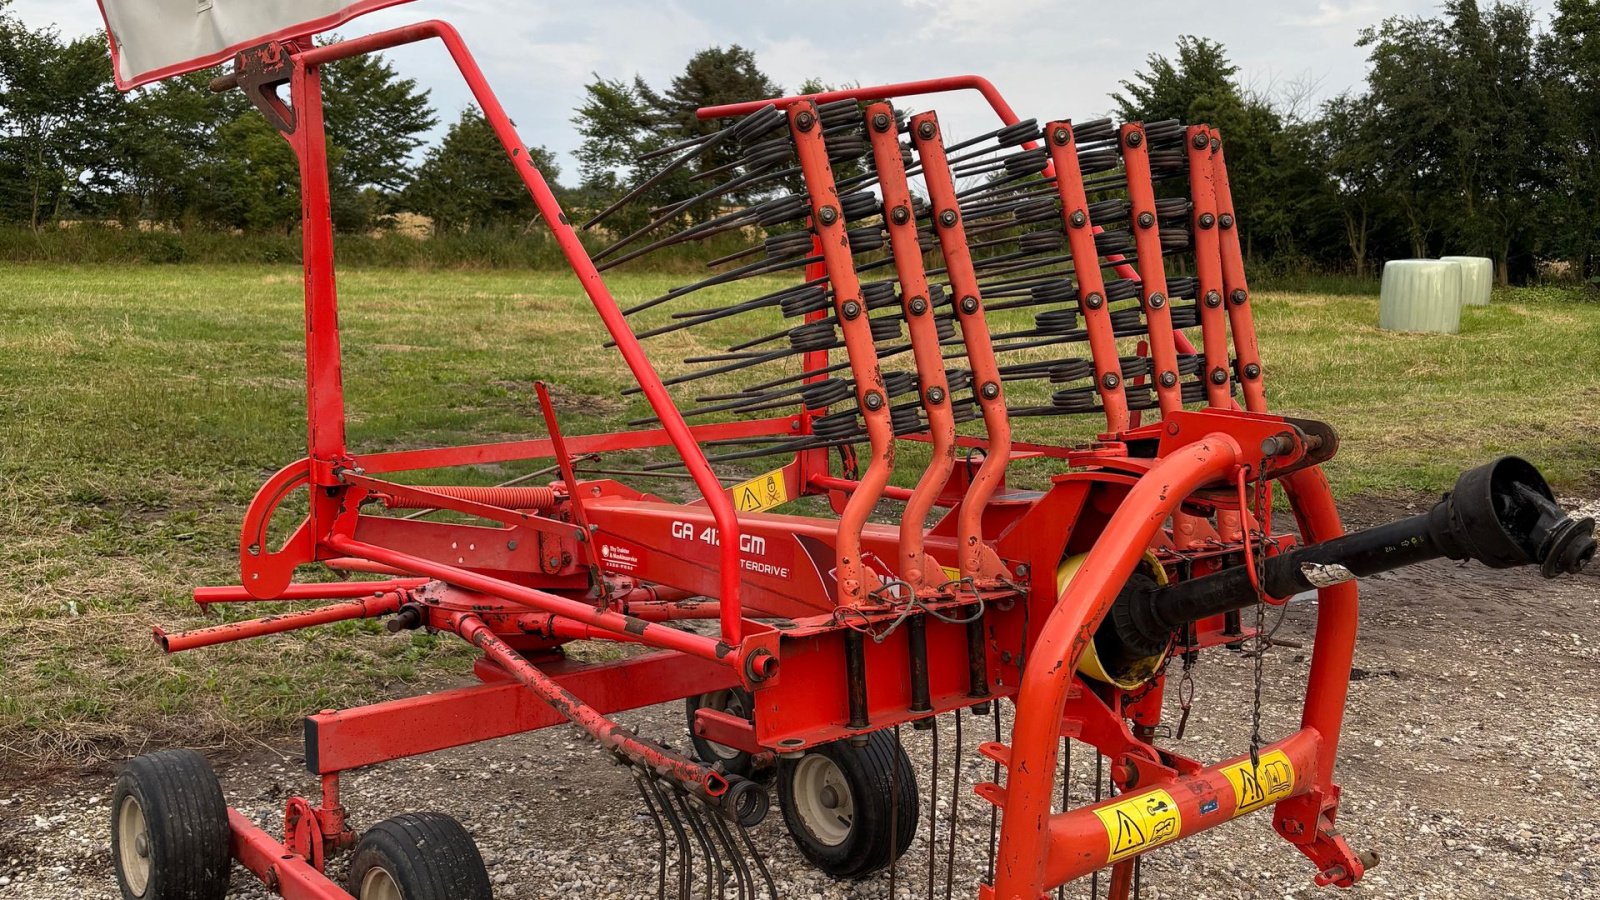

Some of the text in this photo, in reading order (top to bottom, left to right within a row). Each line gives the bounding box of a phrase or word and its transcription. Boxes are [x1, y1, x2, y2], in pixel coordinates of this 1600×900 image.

[672, 520, 694, 541] GA
[739, 533, 766, 556] GM
[740, 559, 788, 578] TERDRIVE
